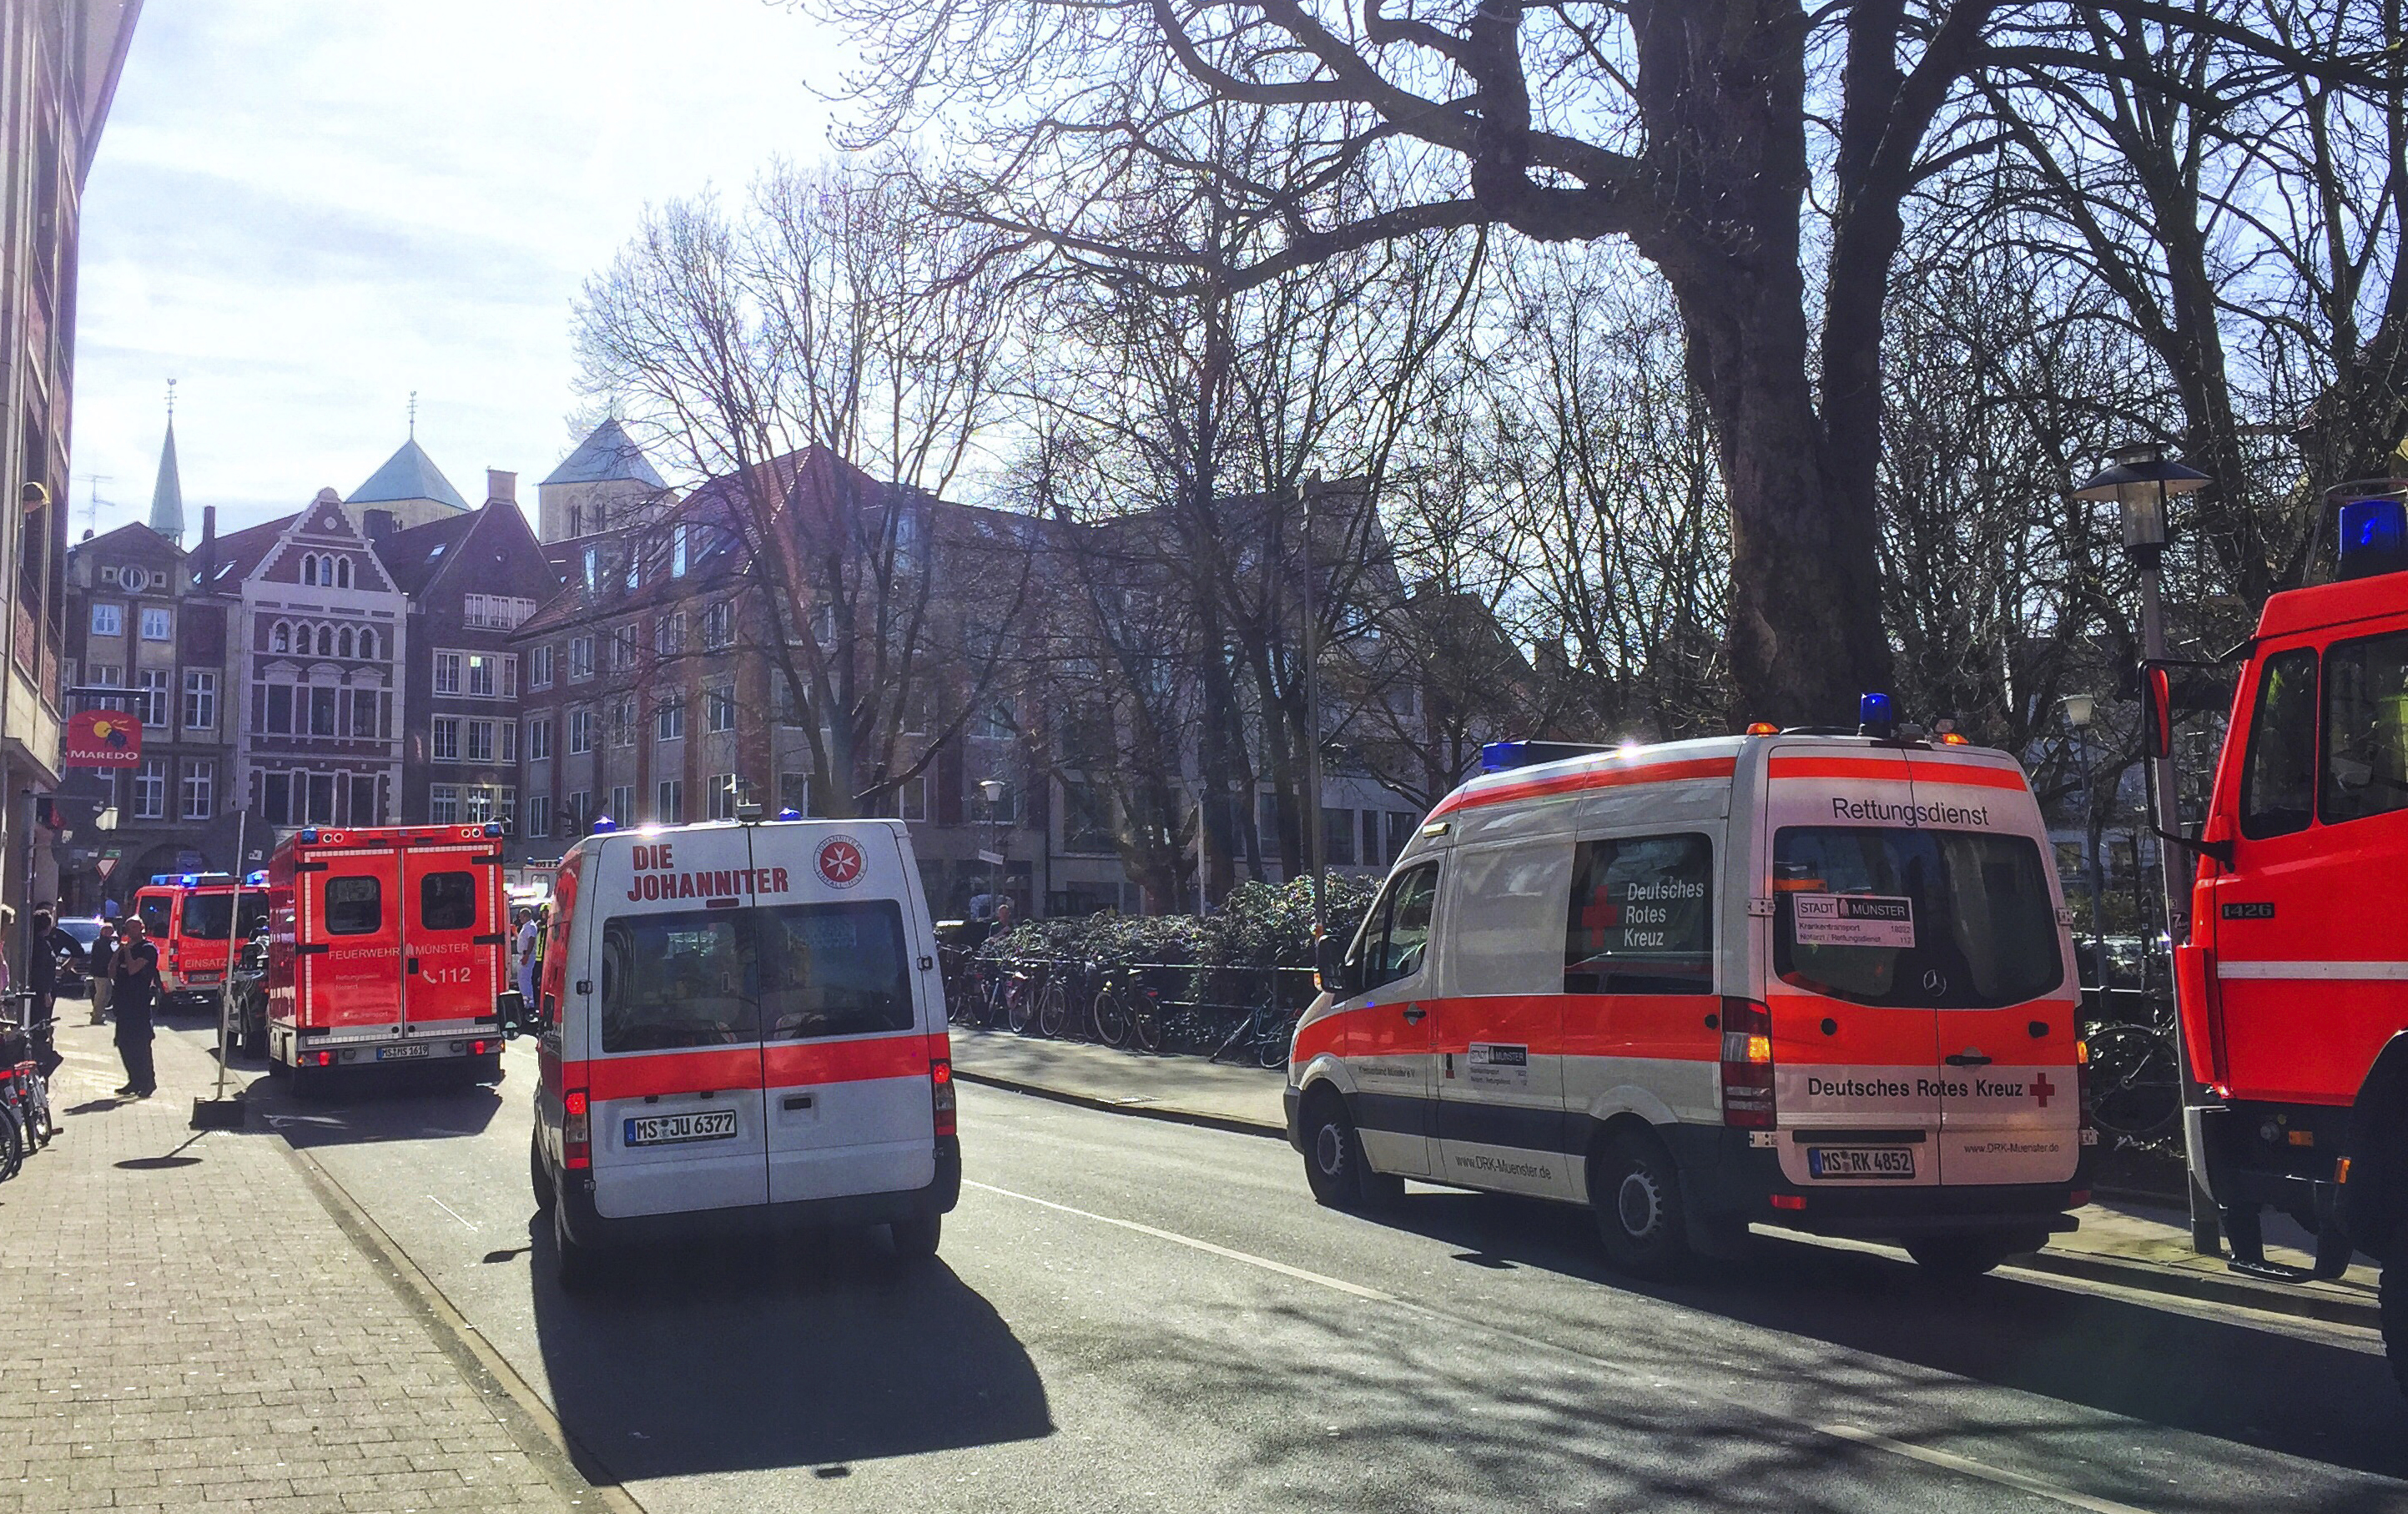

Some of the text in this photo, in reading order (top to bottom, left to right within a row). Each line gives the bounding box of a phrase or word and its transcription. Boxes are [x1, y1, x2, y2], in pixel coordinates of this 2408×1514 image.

[70, 750, 139, 760] MAREDO
[1832, 797, 1989, 826] Rettungsdienst
[632, 843, 673, 871] DIE
[627, 868, 789, 902] JOHANNITER
[1628, 879, 1704, 901] Deutsches
[1625, 905, 1666, 923] Rotes
[1801, 903, 1905, 916] STADT MÜNSTER
[2224, 904, 2272, 917] 1426
[1624, 928, 1664, 947] Kreuz
[329, 943, 469, 959] FEUERWEHR MÜNSTER
[439, 967, 471, 983] 112
[409, 1044, 428, 1054] 1619
[1808, 1077, 2023, 1097] Deutsches Rotes Kreuz
[637, 1120, 657, 1139] MS
[670, 1118, 690, 1136] JU
[694, 1114, 733, 1134] 6377
[1821, 1153, 1911, 1170] MS RK 4852
